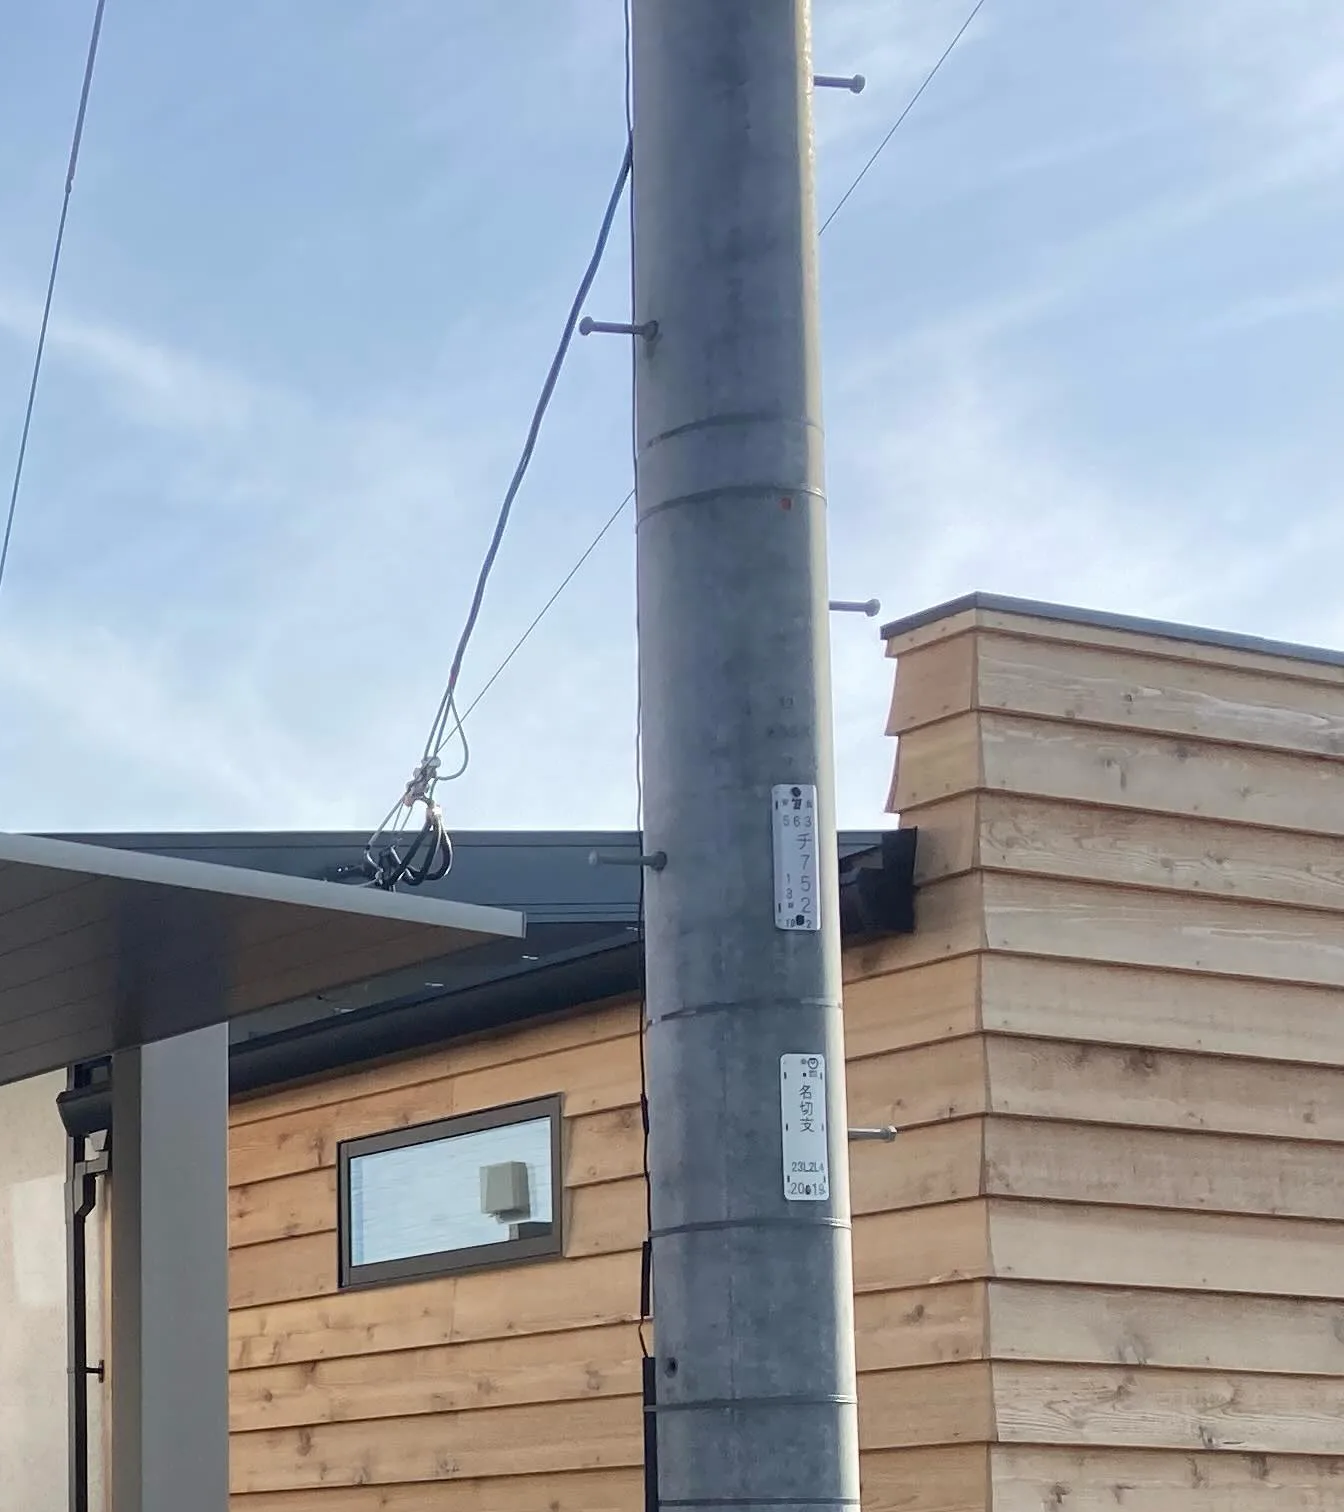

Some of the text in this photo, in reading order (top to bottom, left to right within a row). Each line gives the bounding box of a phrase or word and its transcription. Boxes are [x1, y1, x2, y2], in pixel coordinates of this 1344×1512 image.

[783, 814, 812, 828] 563
[799, 1084, 815, 1133] 名切支
